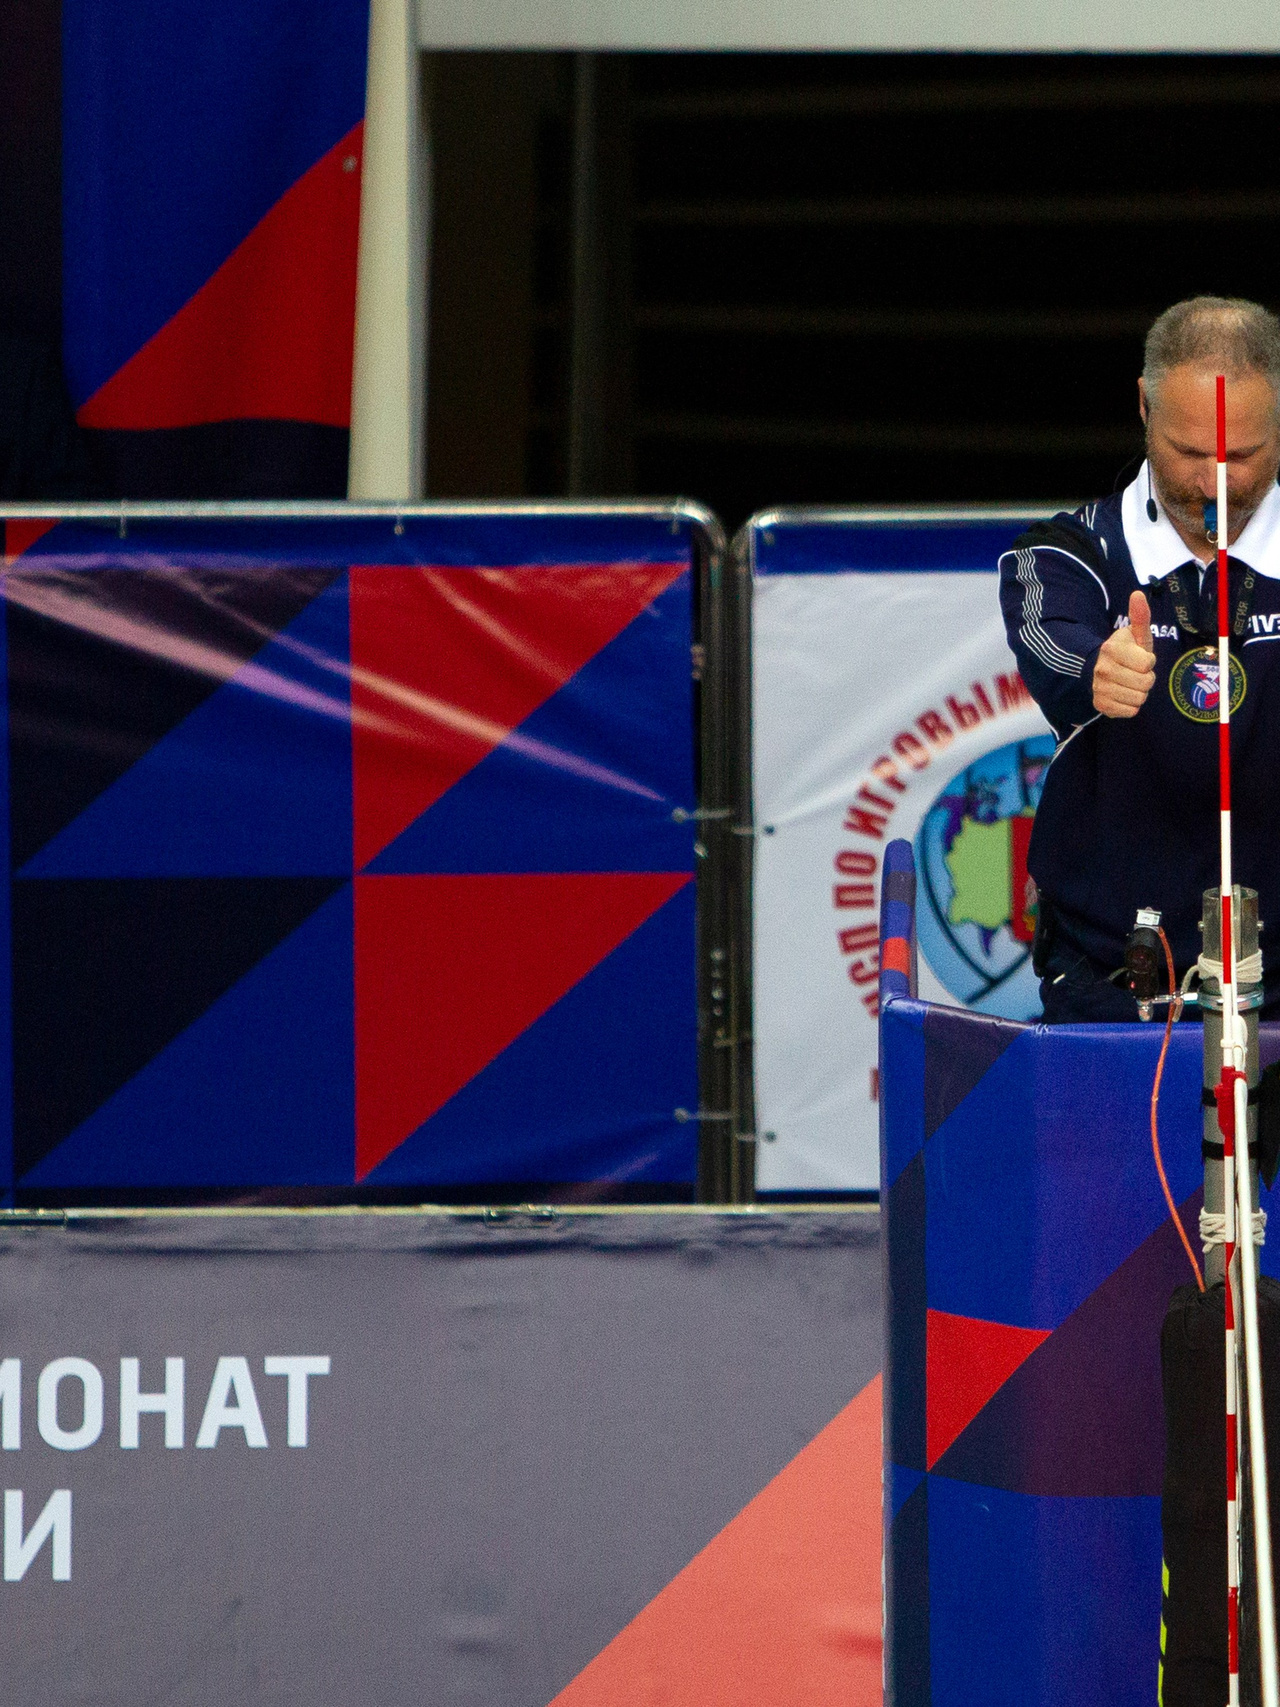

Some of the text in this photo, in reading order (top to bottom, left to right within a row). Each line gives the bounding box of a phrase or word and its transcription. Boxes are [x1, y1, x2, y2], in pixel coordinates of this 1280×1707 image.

[1113, 614, 1178, 640] MASA
[832, 671, 1033, 1018] СП ПО ИГРОВЫМ
